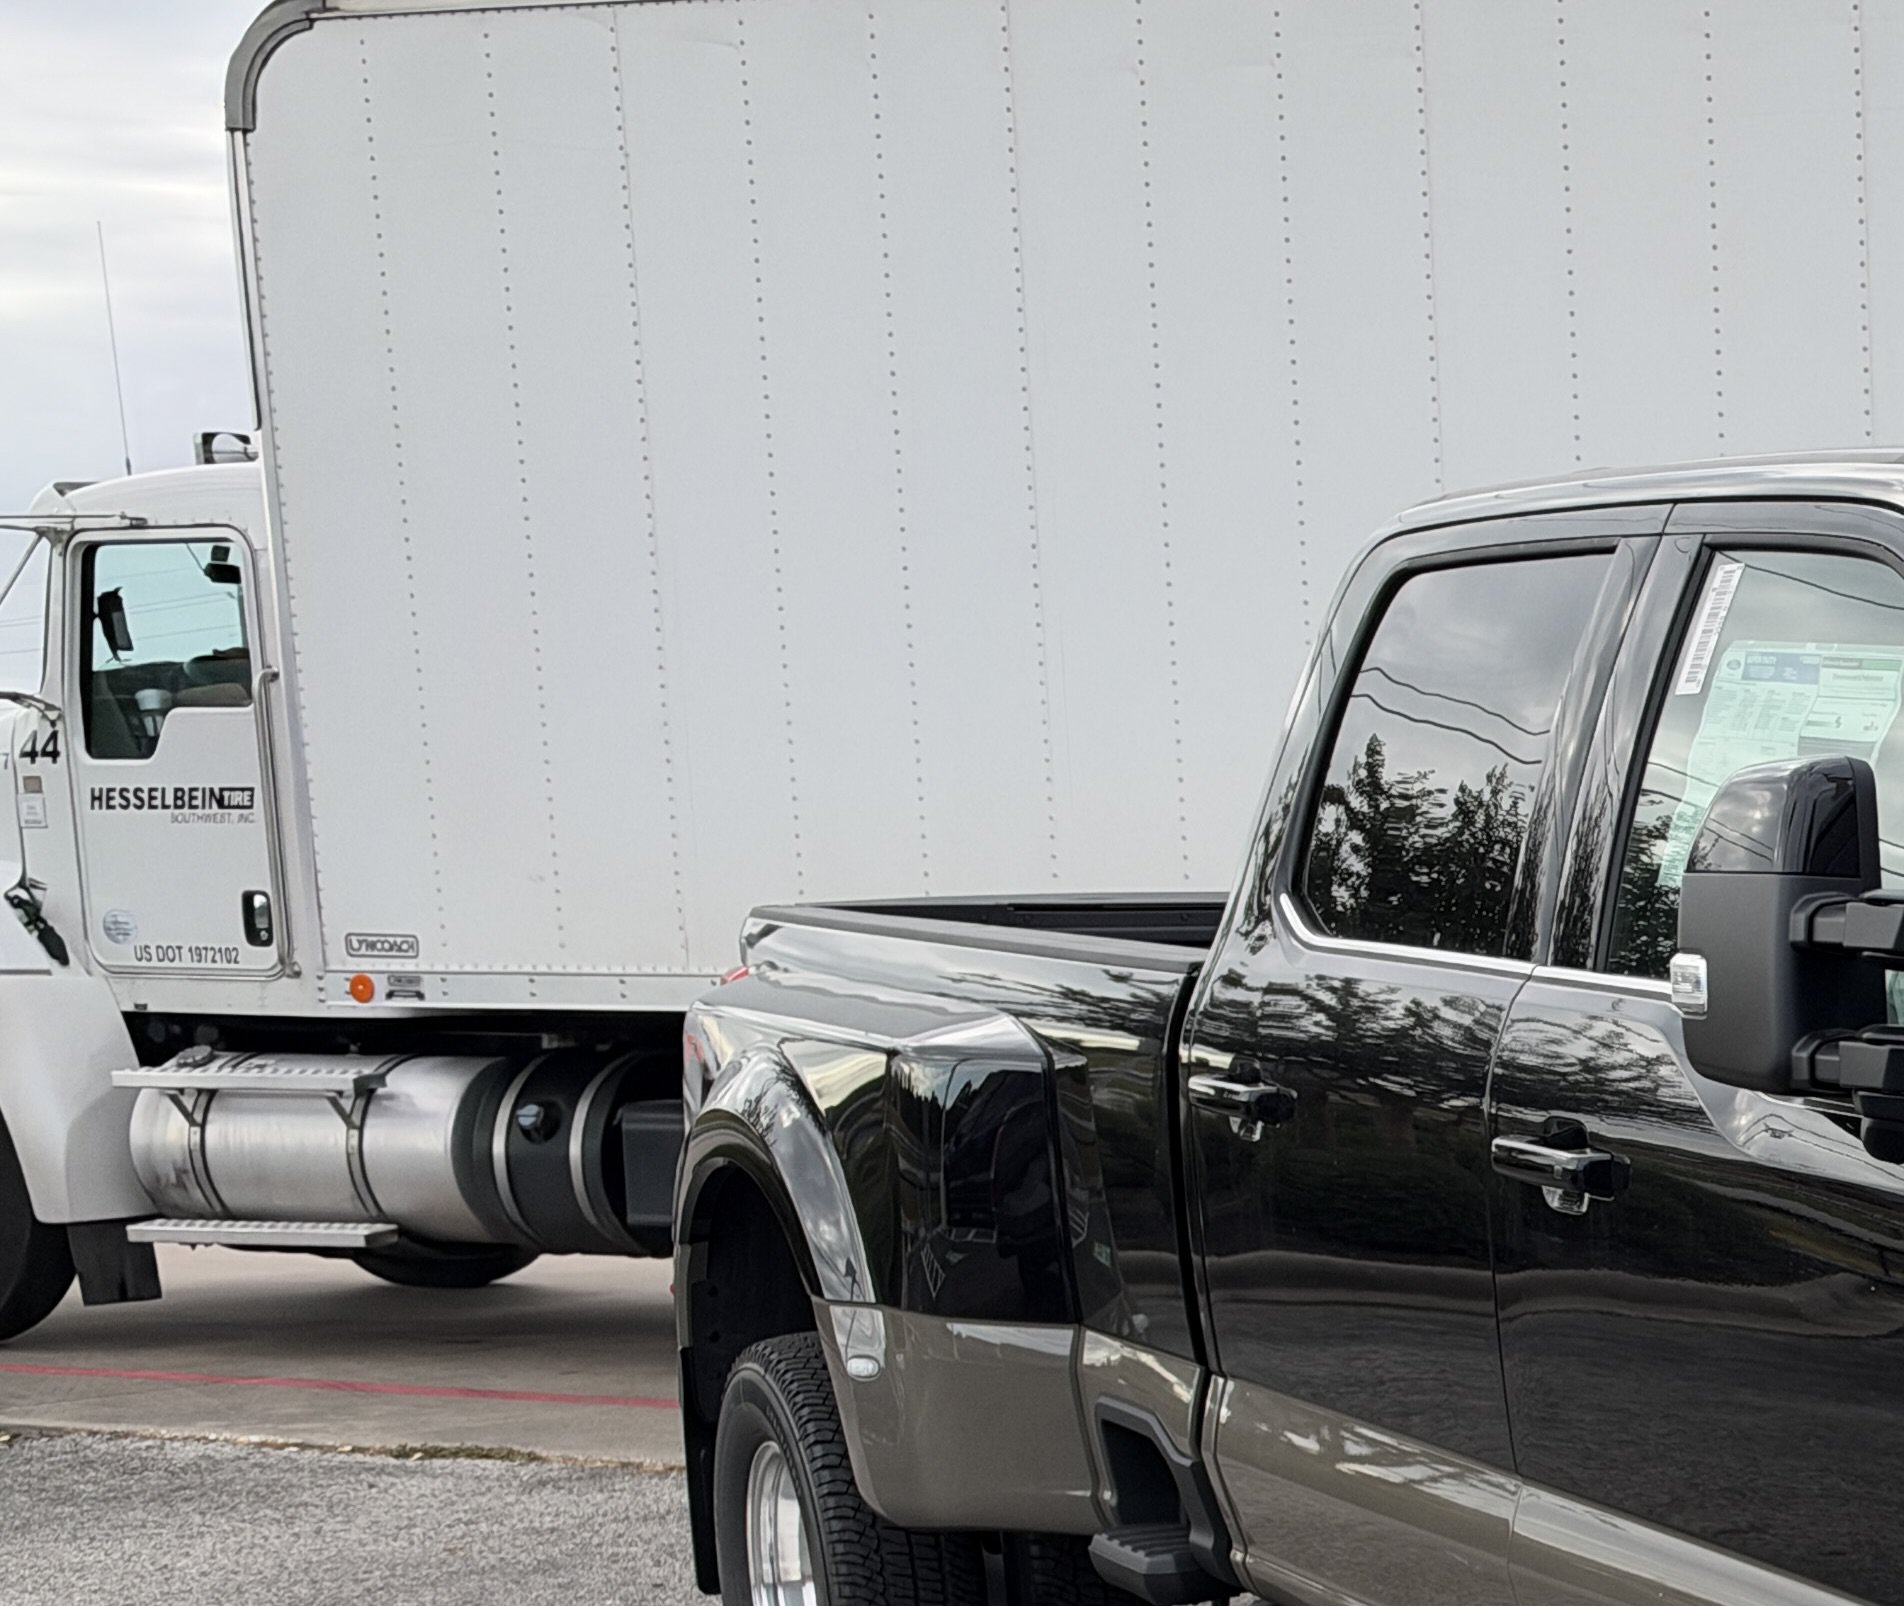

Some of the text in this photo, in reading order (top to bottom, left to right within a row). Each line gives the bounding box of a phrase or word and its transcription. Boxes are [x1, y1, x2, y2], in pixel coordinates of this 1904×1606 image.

[19, 730, 60, 765] 44
[90, 787, 254, 810] HESSELBEIN TIRE
[134, 945, 241, 964] US DOT 1972102
